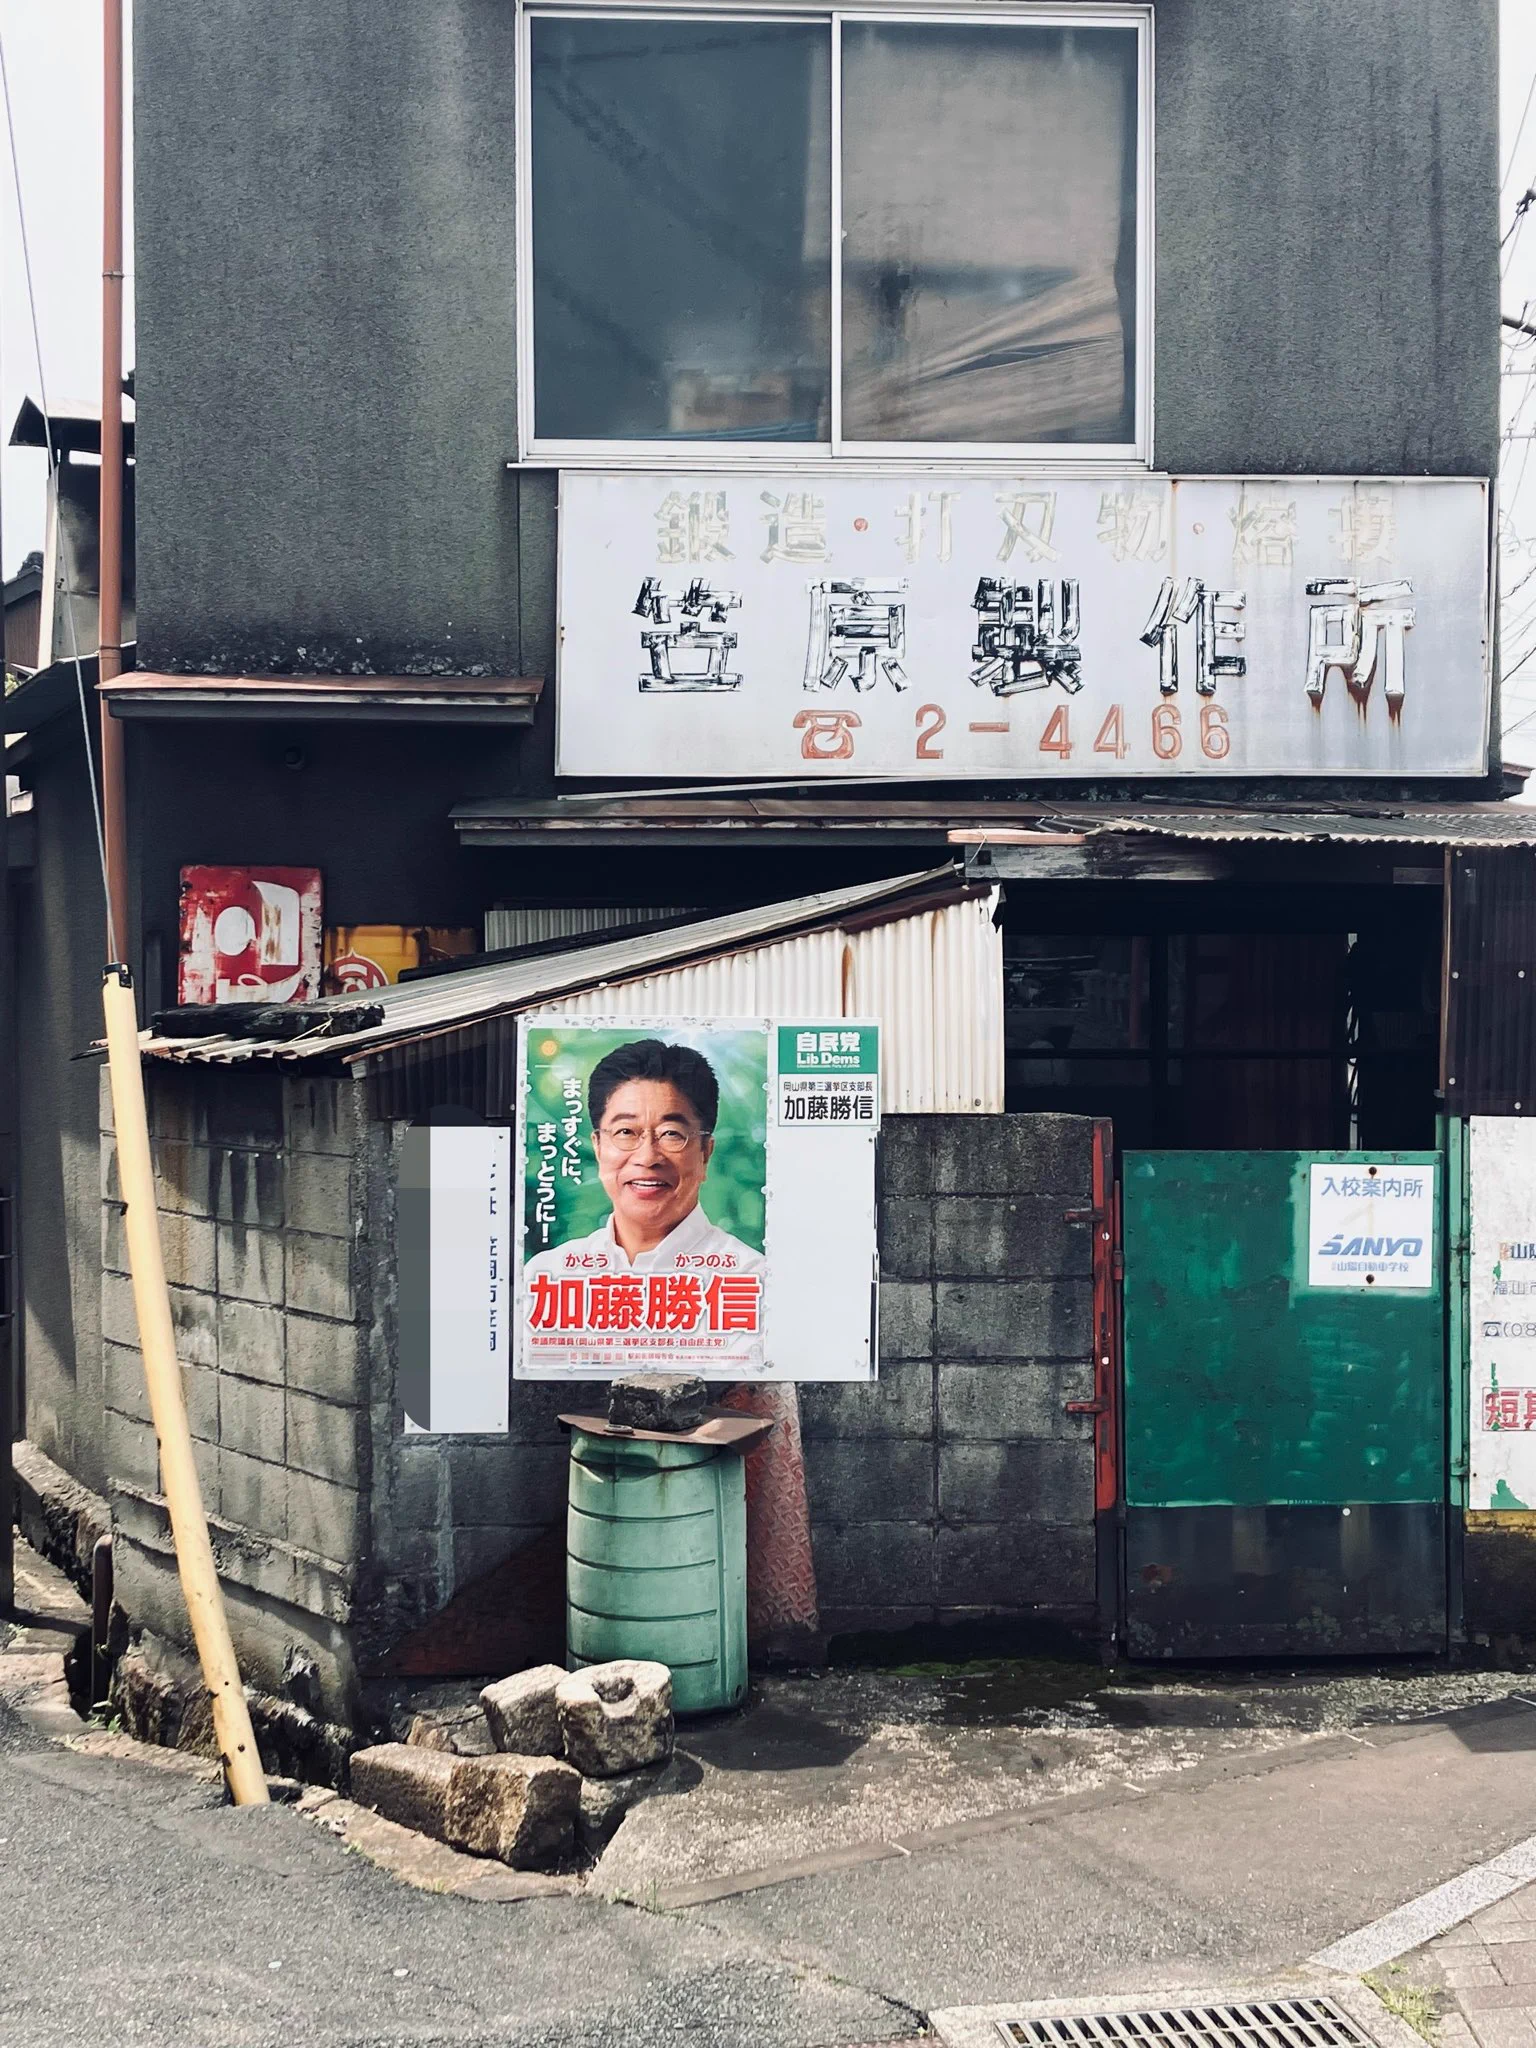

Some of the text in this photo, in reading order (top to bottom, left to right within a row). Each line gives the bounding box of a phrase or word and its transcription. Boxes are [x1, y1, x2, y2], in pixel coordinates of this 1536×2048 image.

[631, 576, 1416, 697] 笠原製作所
[796, 1032, 860, 1052] 自民党
[797, 1052, 860, 1065] Lib Dems
[783, 1081, 873, 1092] 岡山県第三選挙区支部長
[784, 1095, 874, 1120] 加藤勝信
[561, 1077, 583, 1185] まっすぐに、
[1321, 1176, 1423, 1198] 入校案内所
[1318, 1233, 1423, 1257] SANYO
[565, 1253, 737, 1267] かとう かつのぶ
[529, 1273, 761, 1331] 加藤勝信
